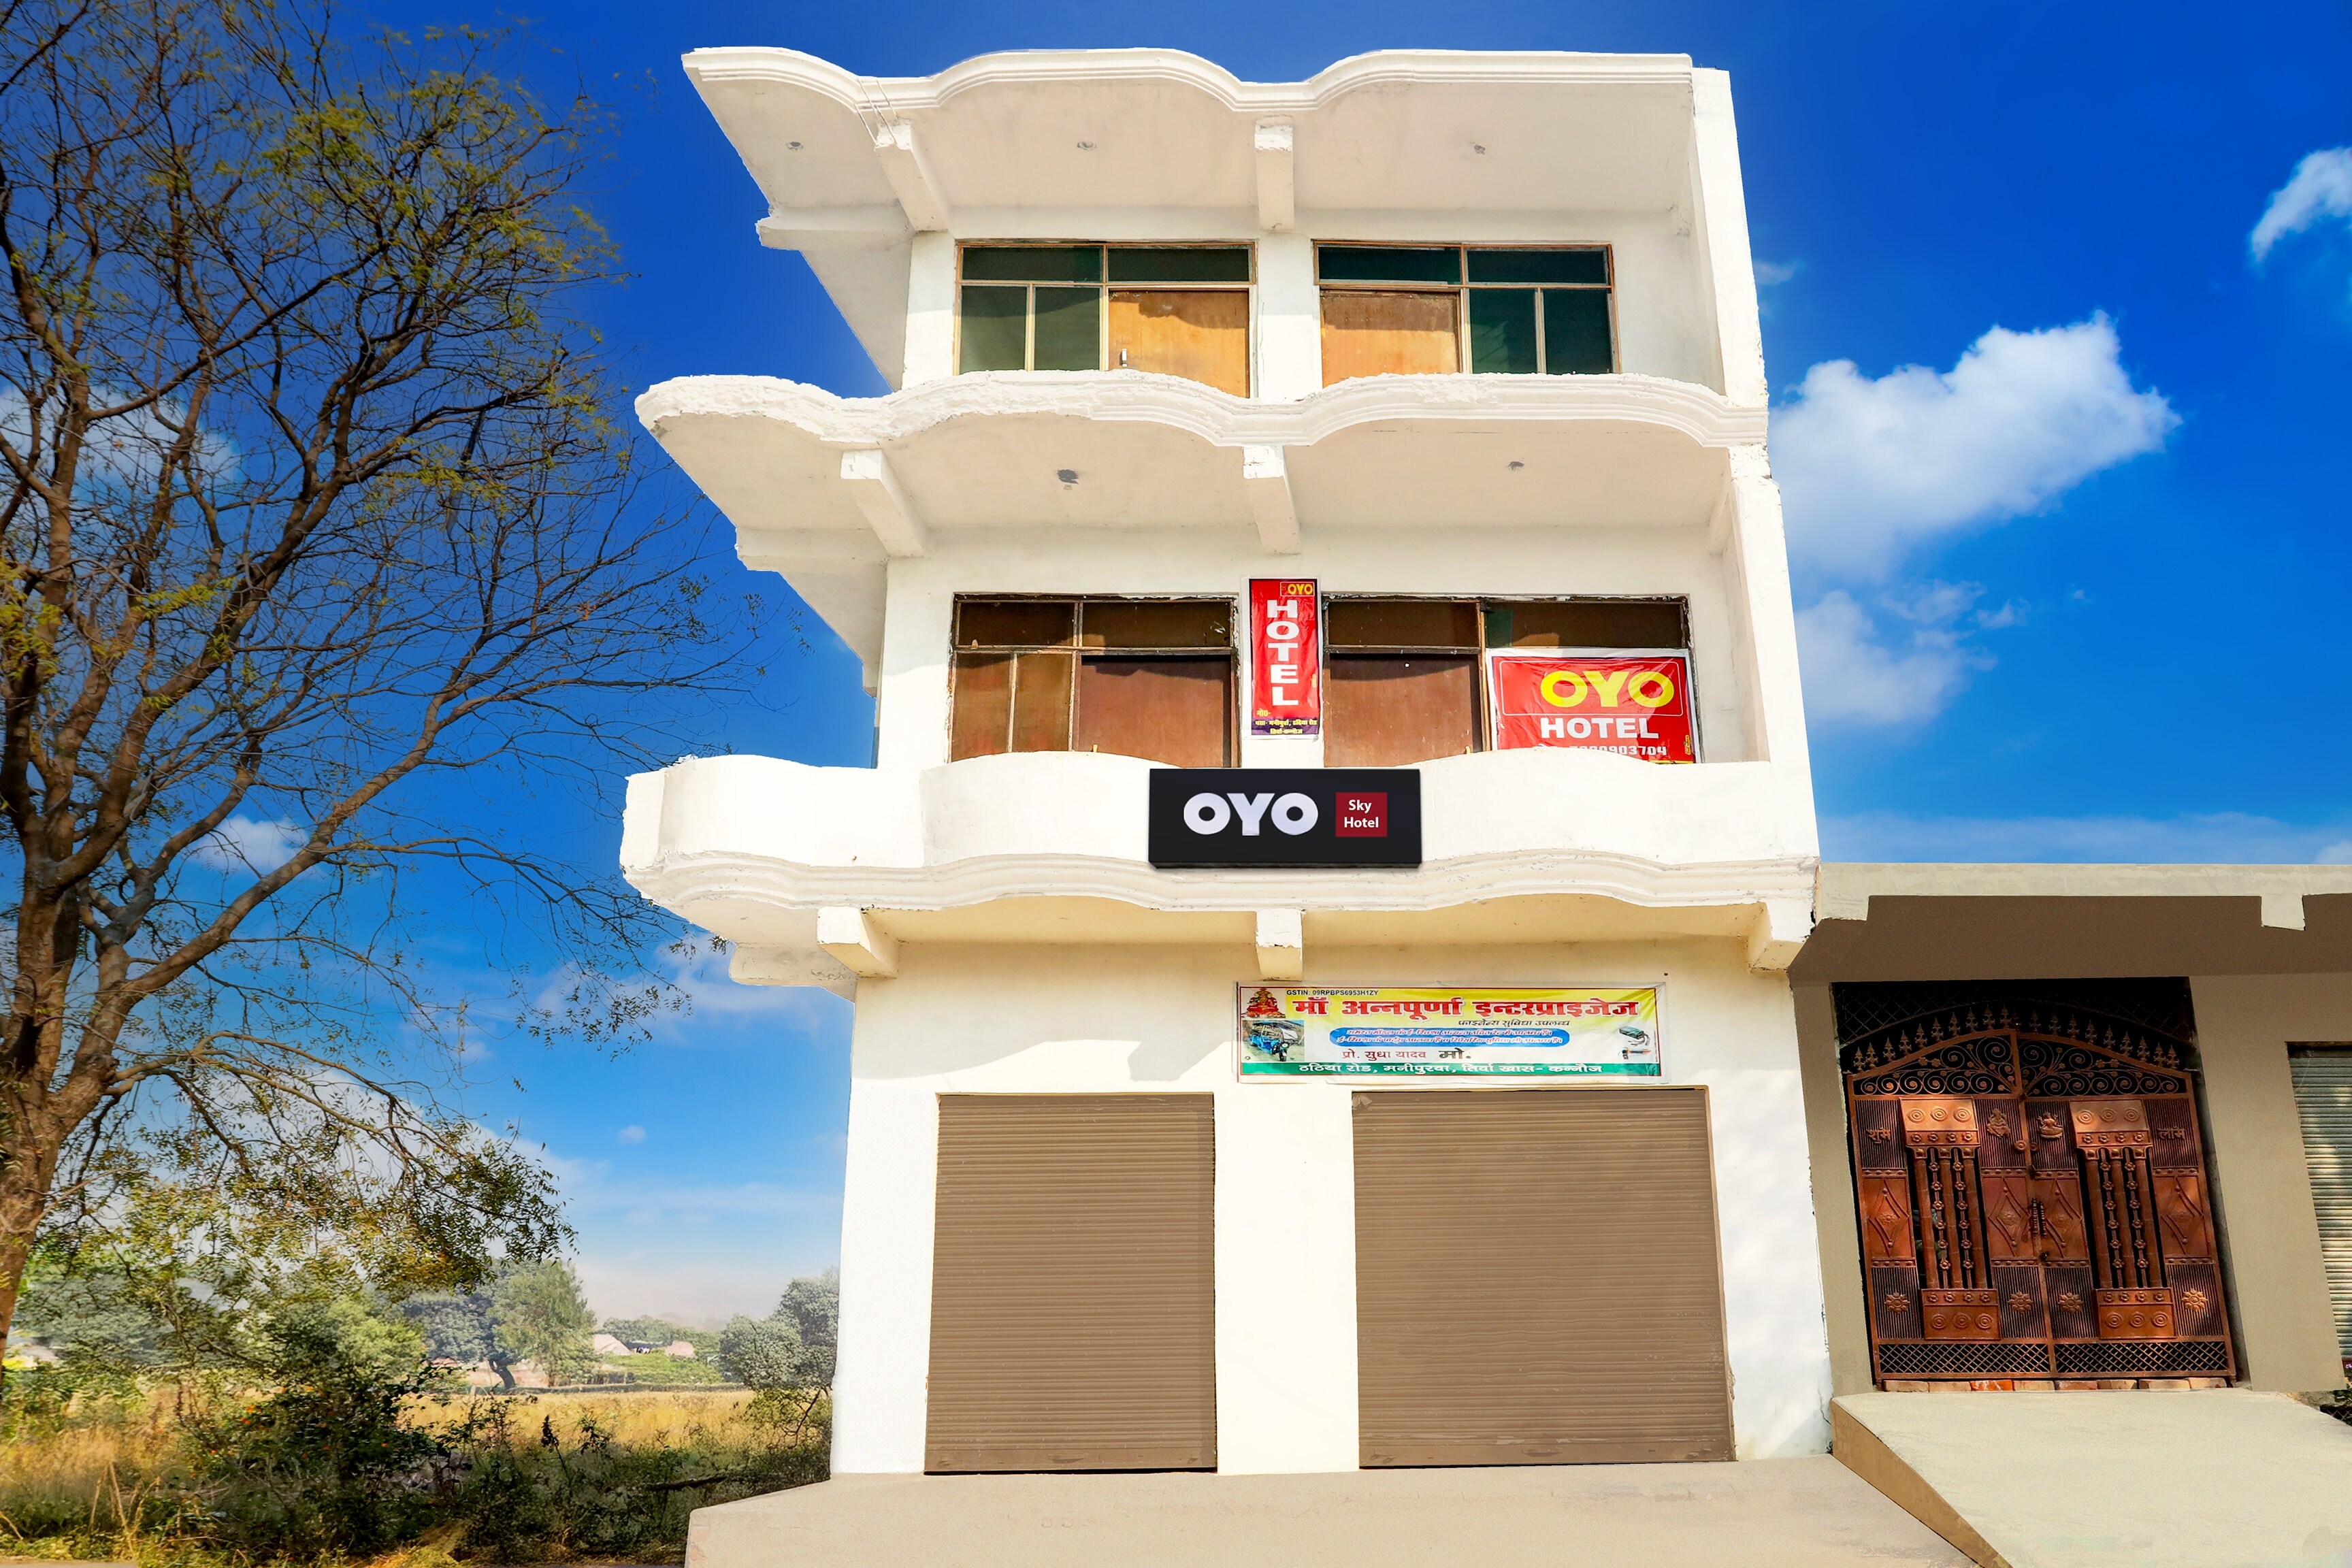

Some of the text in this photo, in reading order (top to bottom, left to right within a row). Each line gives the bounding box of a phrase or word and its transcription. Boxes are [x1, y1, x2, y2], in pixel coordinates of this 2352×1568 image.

[1287, 583, 1313, 595] OYO
[1266, 599, 1300, 706] HOTEL
[1540, 670, 1674, 708] OYO
[1540, 717, 1659, 739] HOTEL
[1348, 799, 1372, 813] Sky
[1183, 792, 1319, 836] OYO
[1344, 817, 1379, 828] Hotel
[1341, 997, 1463, 1020] अन्नपूर्णा
[1471, 998, 1639, 1017] इन्टरप्राइजेज
[1502, 1019, 1532, 1028] सुविधा
[1342, 1047, 1471, 1062] प्रो. सुधा यादव मो.
[1346, 1063, 1378, 1073] रोड,
[1384, 1063, 1456, 1074] मनीपुरवा,
[1548, 1062, 1602, 1073] कन्नौज
